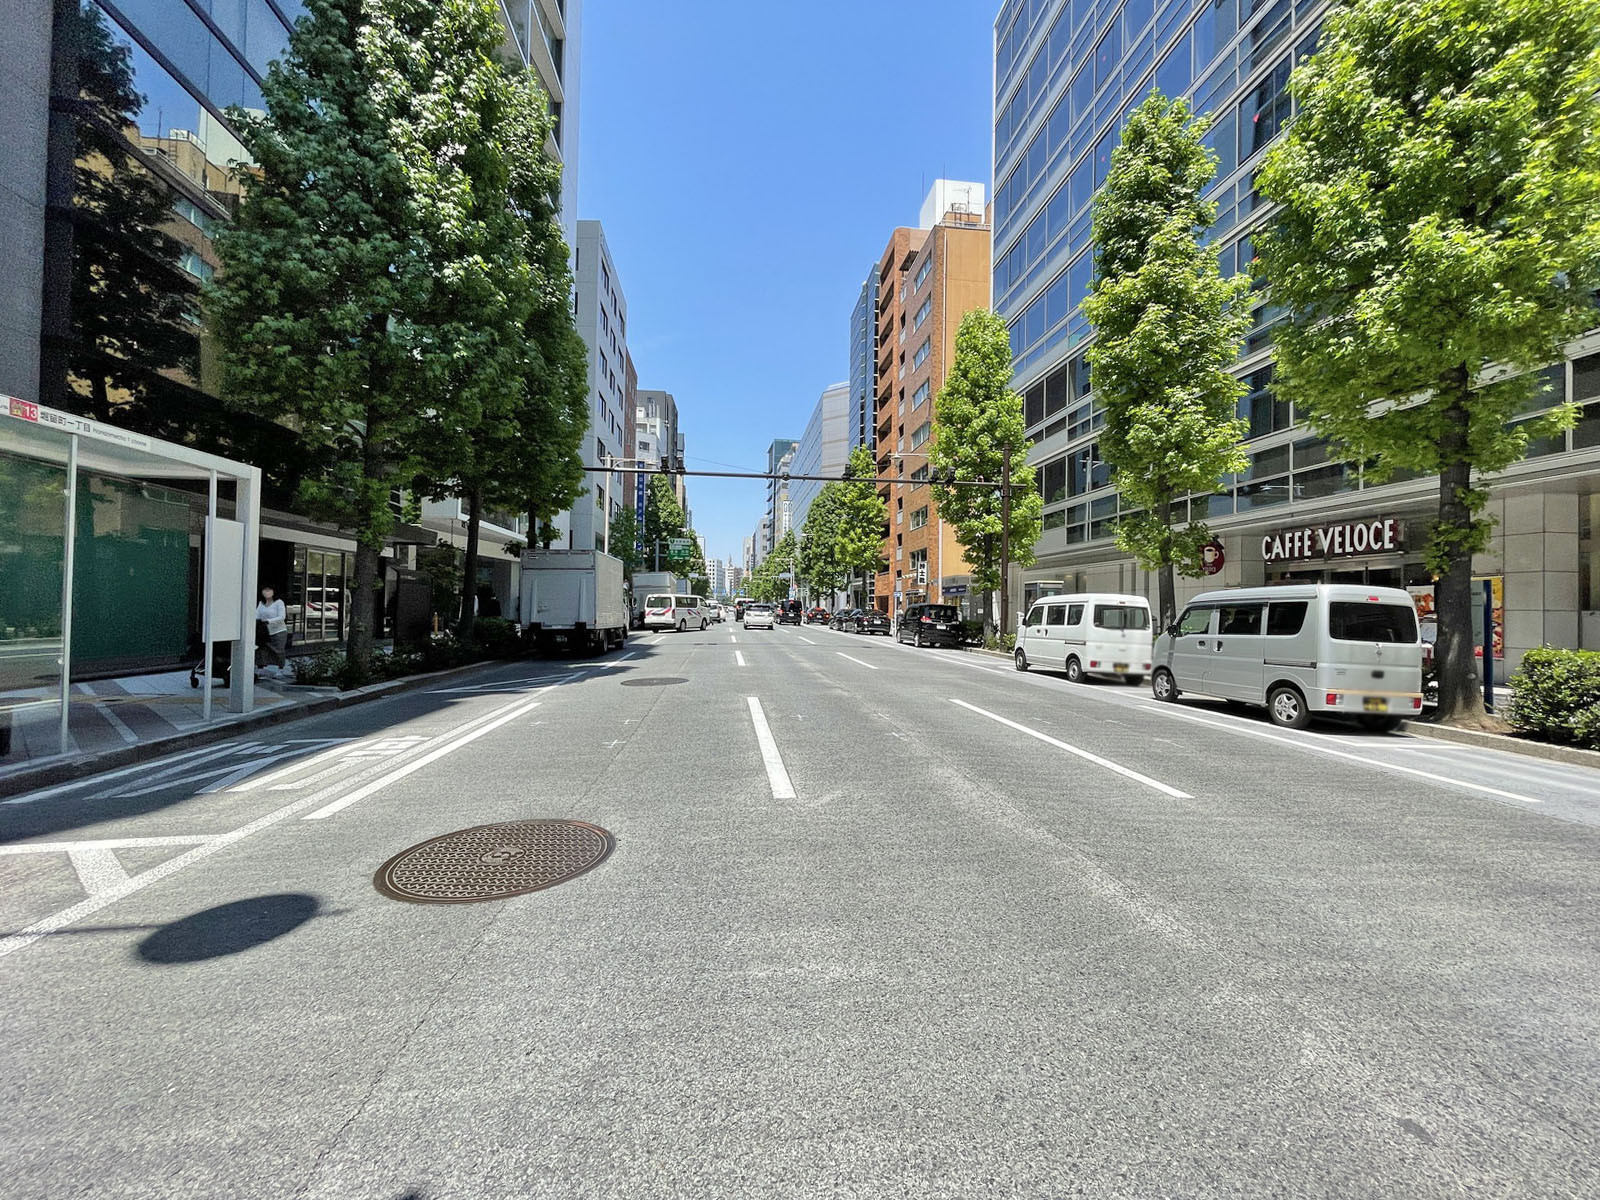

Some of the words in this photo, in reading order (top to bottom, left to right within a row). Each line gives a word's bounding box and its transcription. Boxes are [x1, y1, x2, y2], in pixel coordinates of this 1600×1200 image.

[25, 406, 37, 419] 13
[1262, 528, 1312, 560] CAFFÈ
[1318, 519, 1394, 554] VELOCE
